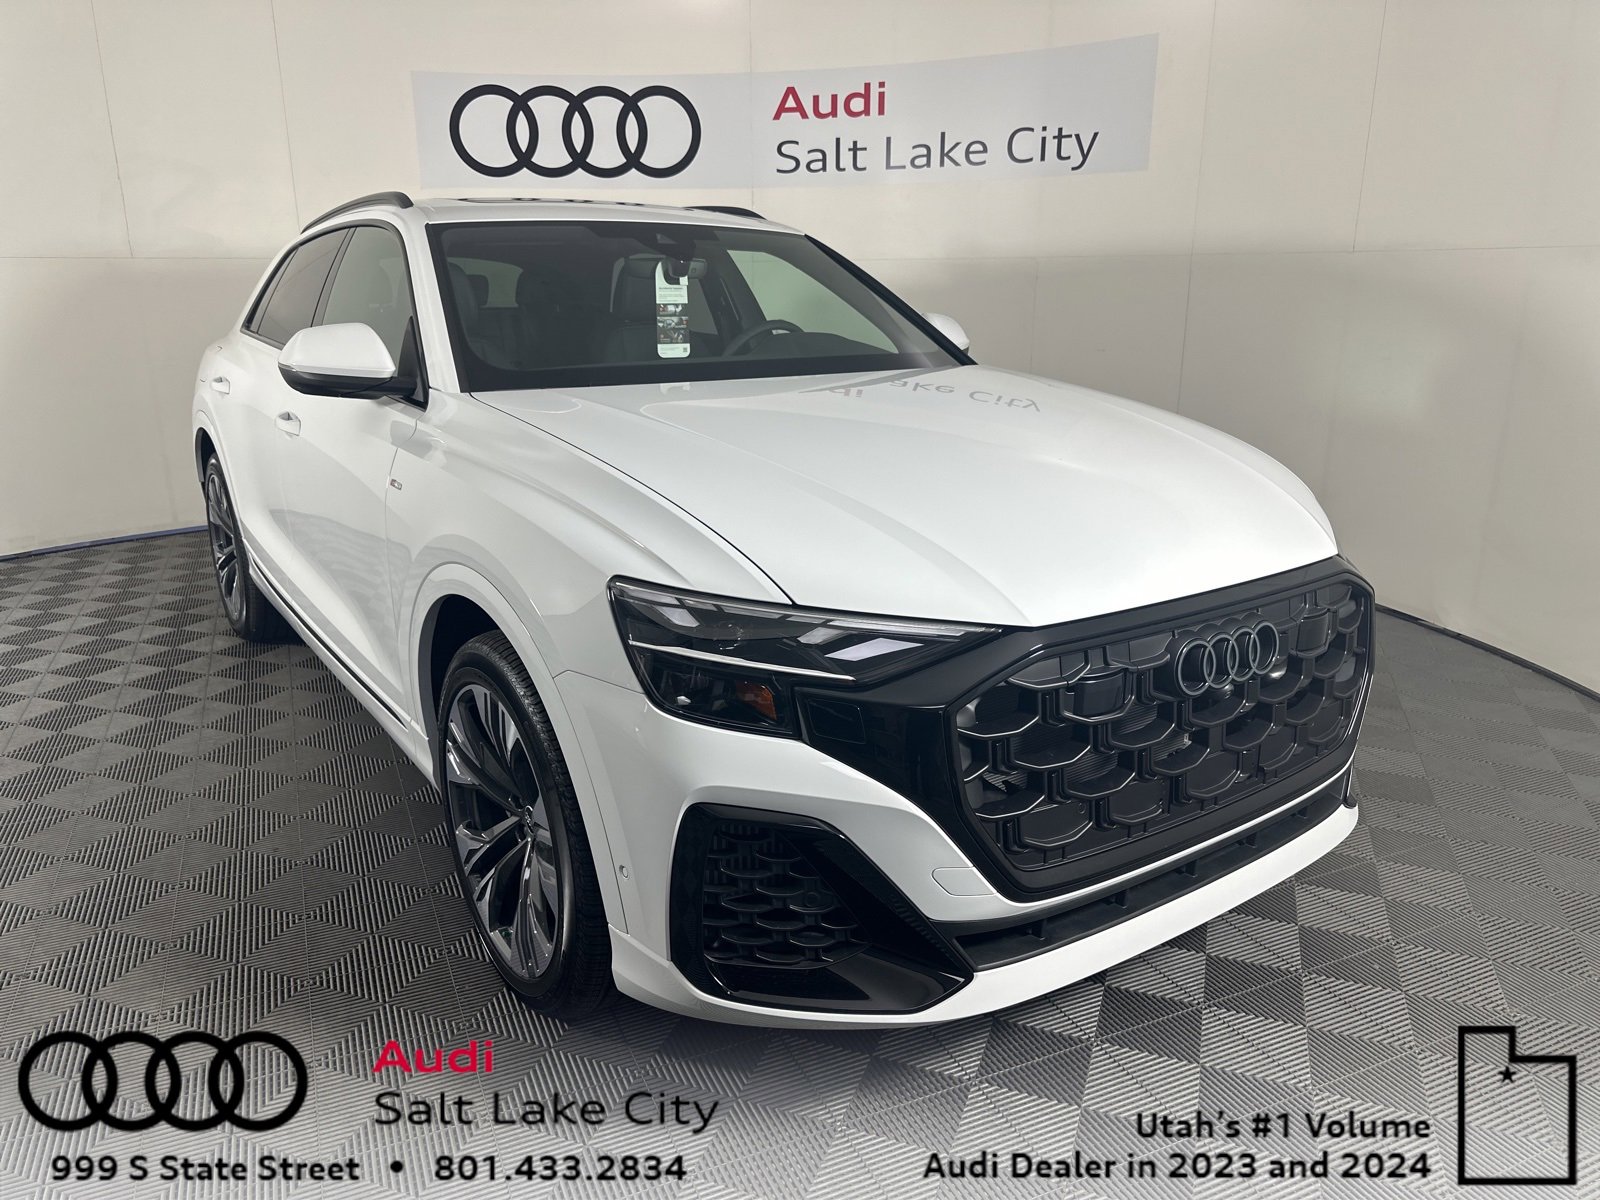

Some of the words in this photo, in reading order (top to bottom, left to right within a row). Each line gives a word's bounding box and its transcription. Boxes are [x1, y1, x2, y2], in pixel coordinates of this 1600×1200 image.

[773, 81, 887, 120] Audi
[775, 136, 868, 175] Salt
[885, 130, 989, 171] Lake
[1005, 125, 1100, 173] City
